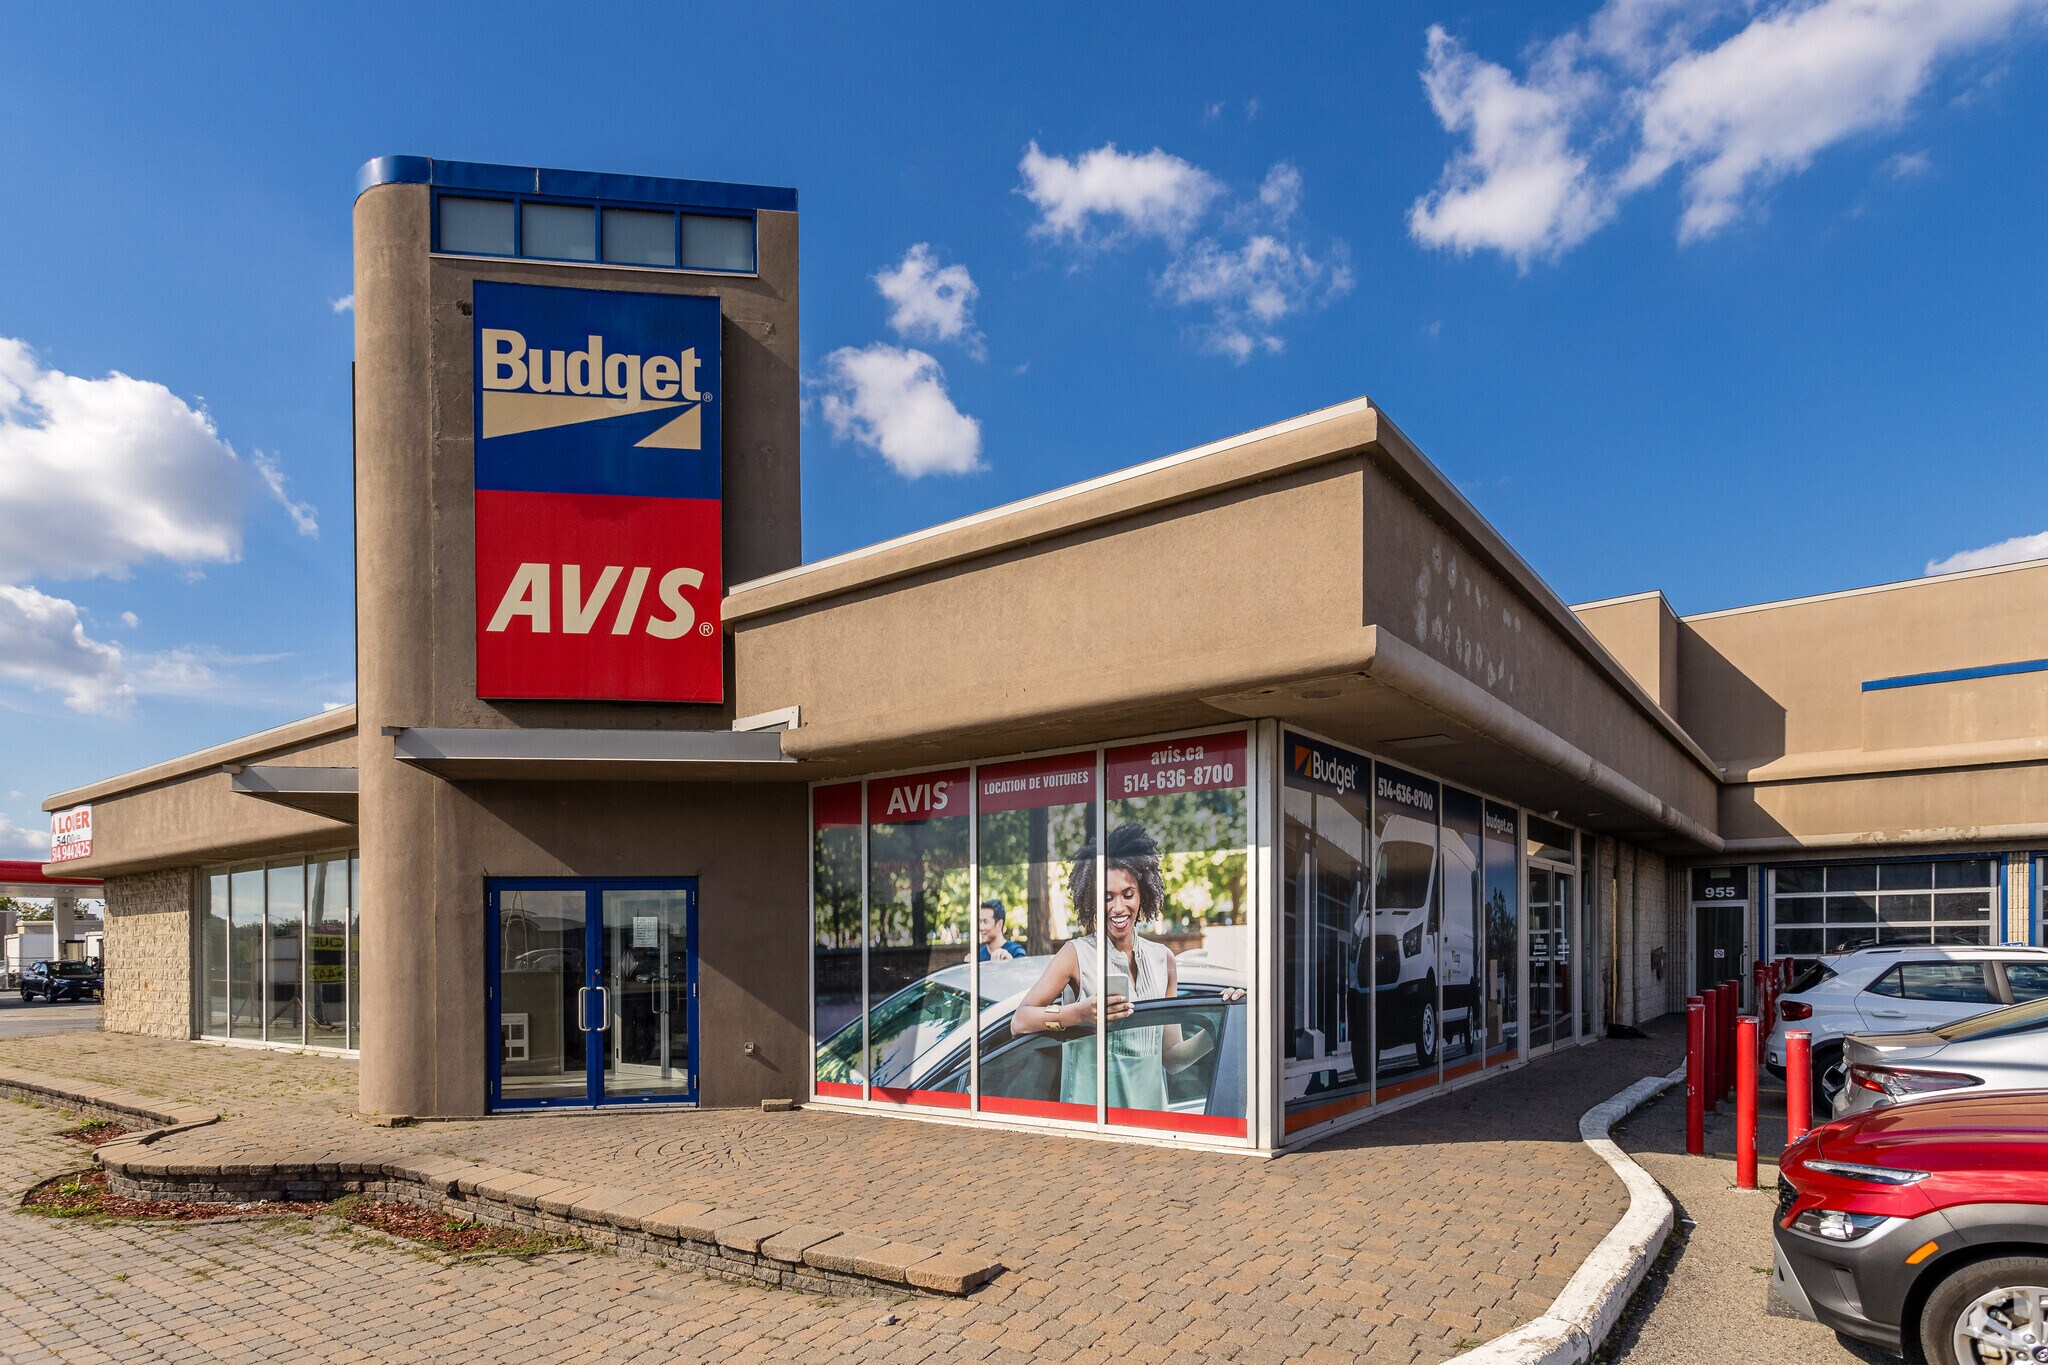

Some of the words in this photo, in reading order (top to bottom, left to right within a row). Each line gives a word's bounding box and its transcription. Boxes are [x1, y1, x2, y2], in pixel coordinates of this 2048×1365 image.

[1151, 745, 1204, 766] avis.ca
[984, 778, 1027, 796] LOCATION
[1029, 777, 1041, 790] DE
[1043, 771, 1090, 789] VOITURES
[1123, 763, 1234, 793] 514-636-8700
[1312, 750, 1356, 795] Budget
[886, 780, 949, 816] AVIS
[1378, 776, 1434, 812] 514-636-8700
[1485, 810, 1514, 835] budget.ca
[1704, 886, 1736, 898] 955
